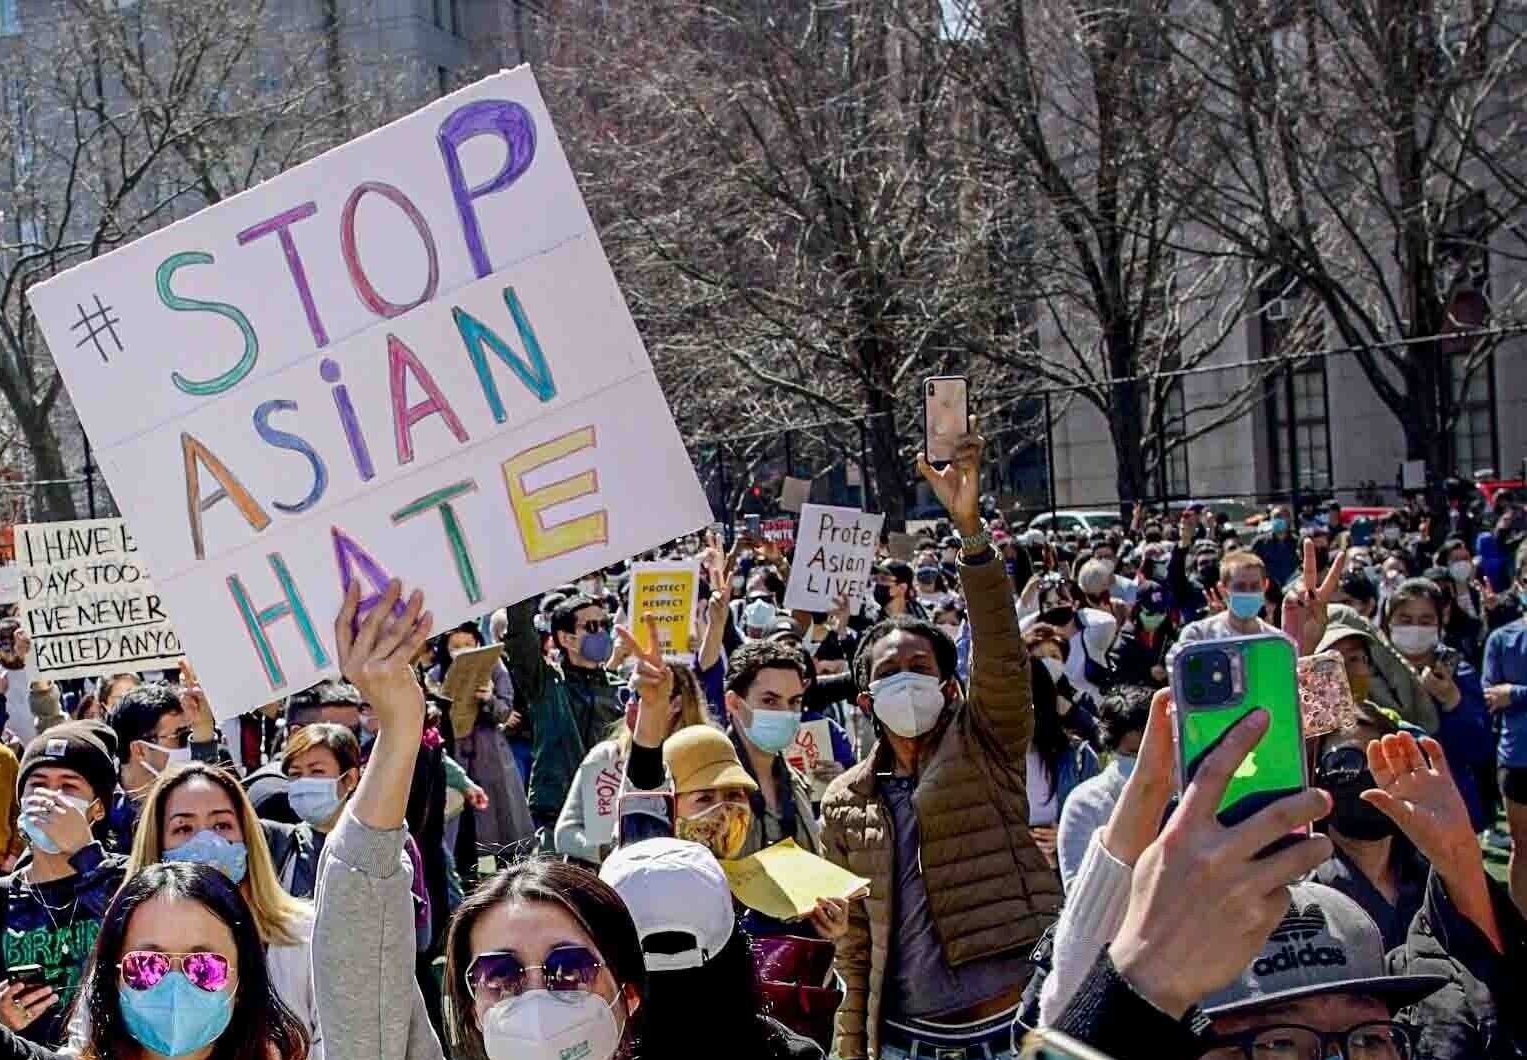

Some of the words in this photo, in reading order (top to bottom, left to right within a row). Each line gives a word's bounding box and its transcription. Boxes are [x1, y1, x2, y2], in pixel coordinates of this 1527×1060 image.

[25, 530, 33, 566] I
[44, 527, 114, 564] HAVE
[225, 424, 609, 692] HATE
[807, 546, 865, 573] Asian
[23, 568, 84, 600] DAYS
[641, 583, 687, 593] PROTECT
[28, 604, 72, 635] I'VE
[78, 594, 167, 627] NEVER
[639, 615, 685, 624] SPPORT
[641, 599, 684, 608] RESPECT
[35, 636, 112, 668] KILLED
[120, 631, 182, 657] ANYO
[1253, 942, 1347, 976] adidas
